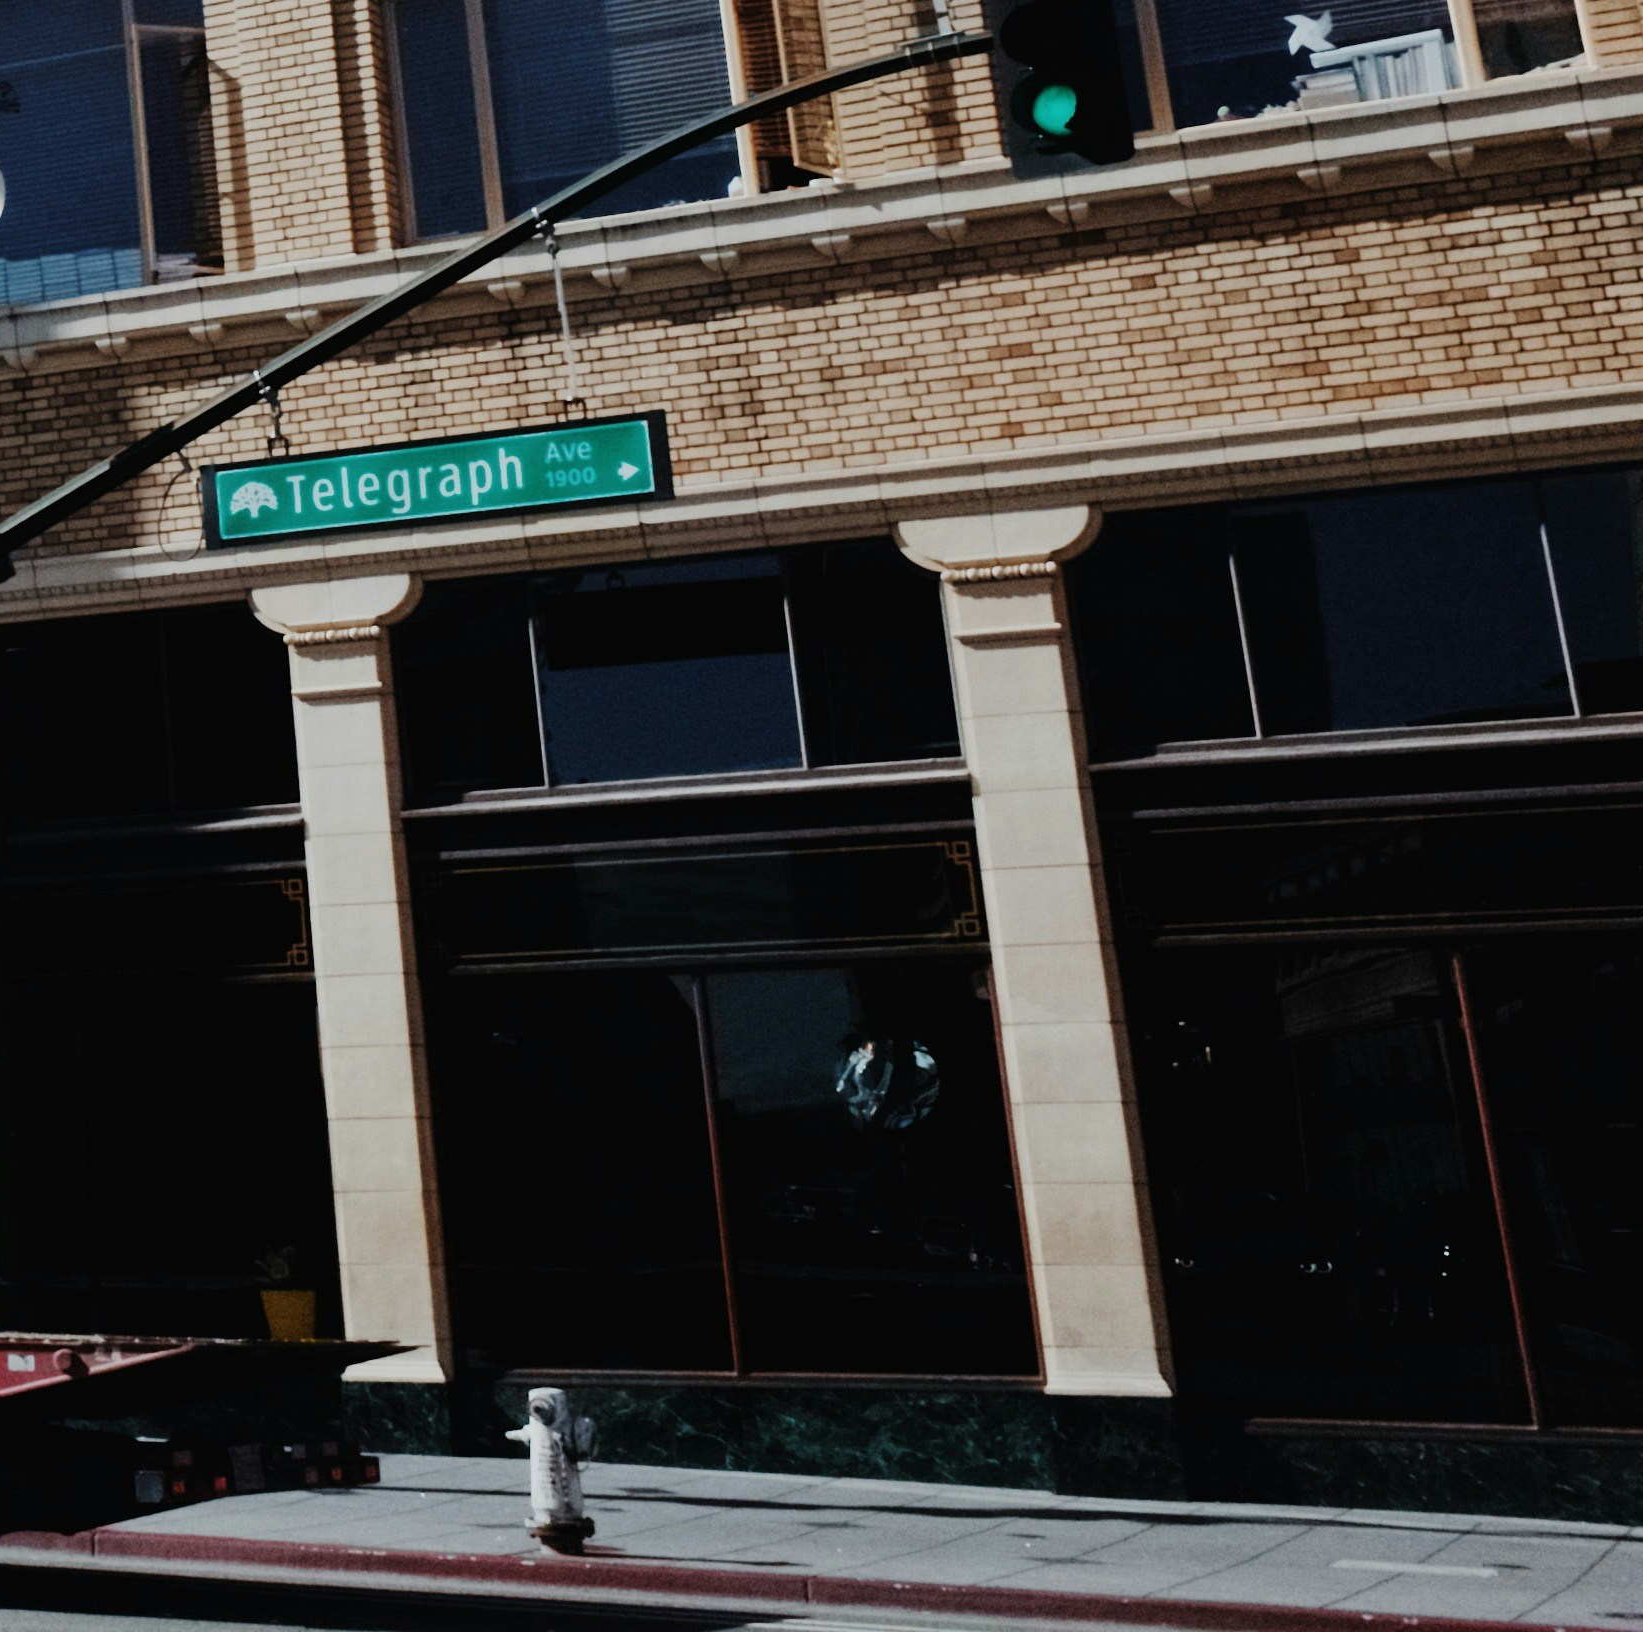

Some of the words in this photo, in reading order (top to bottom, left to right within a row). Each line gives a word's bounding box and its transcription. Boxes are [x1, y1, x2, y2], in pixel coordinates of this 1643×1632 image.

[287, 447, 523, 515] Telegraph
[544, 439, 593, 463] Ave
[545, 467, 596, 489] 1900
